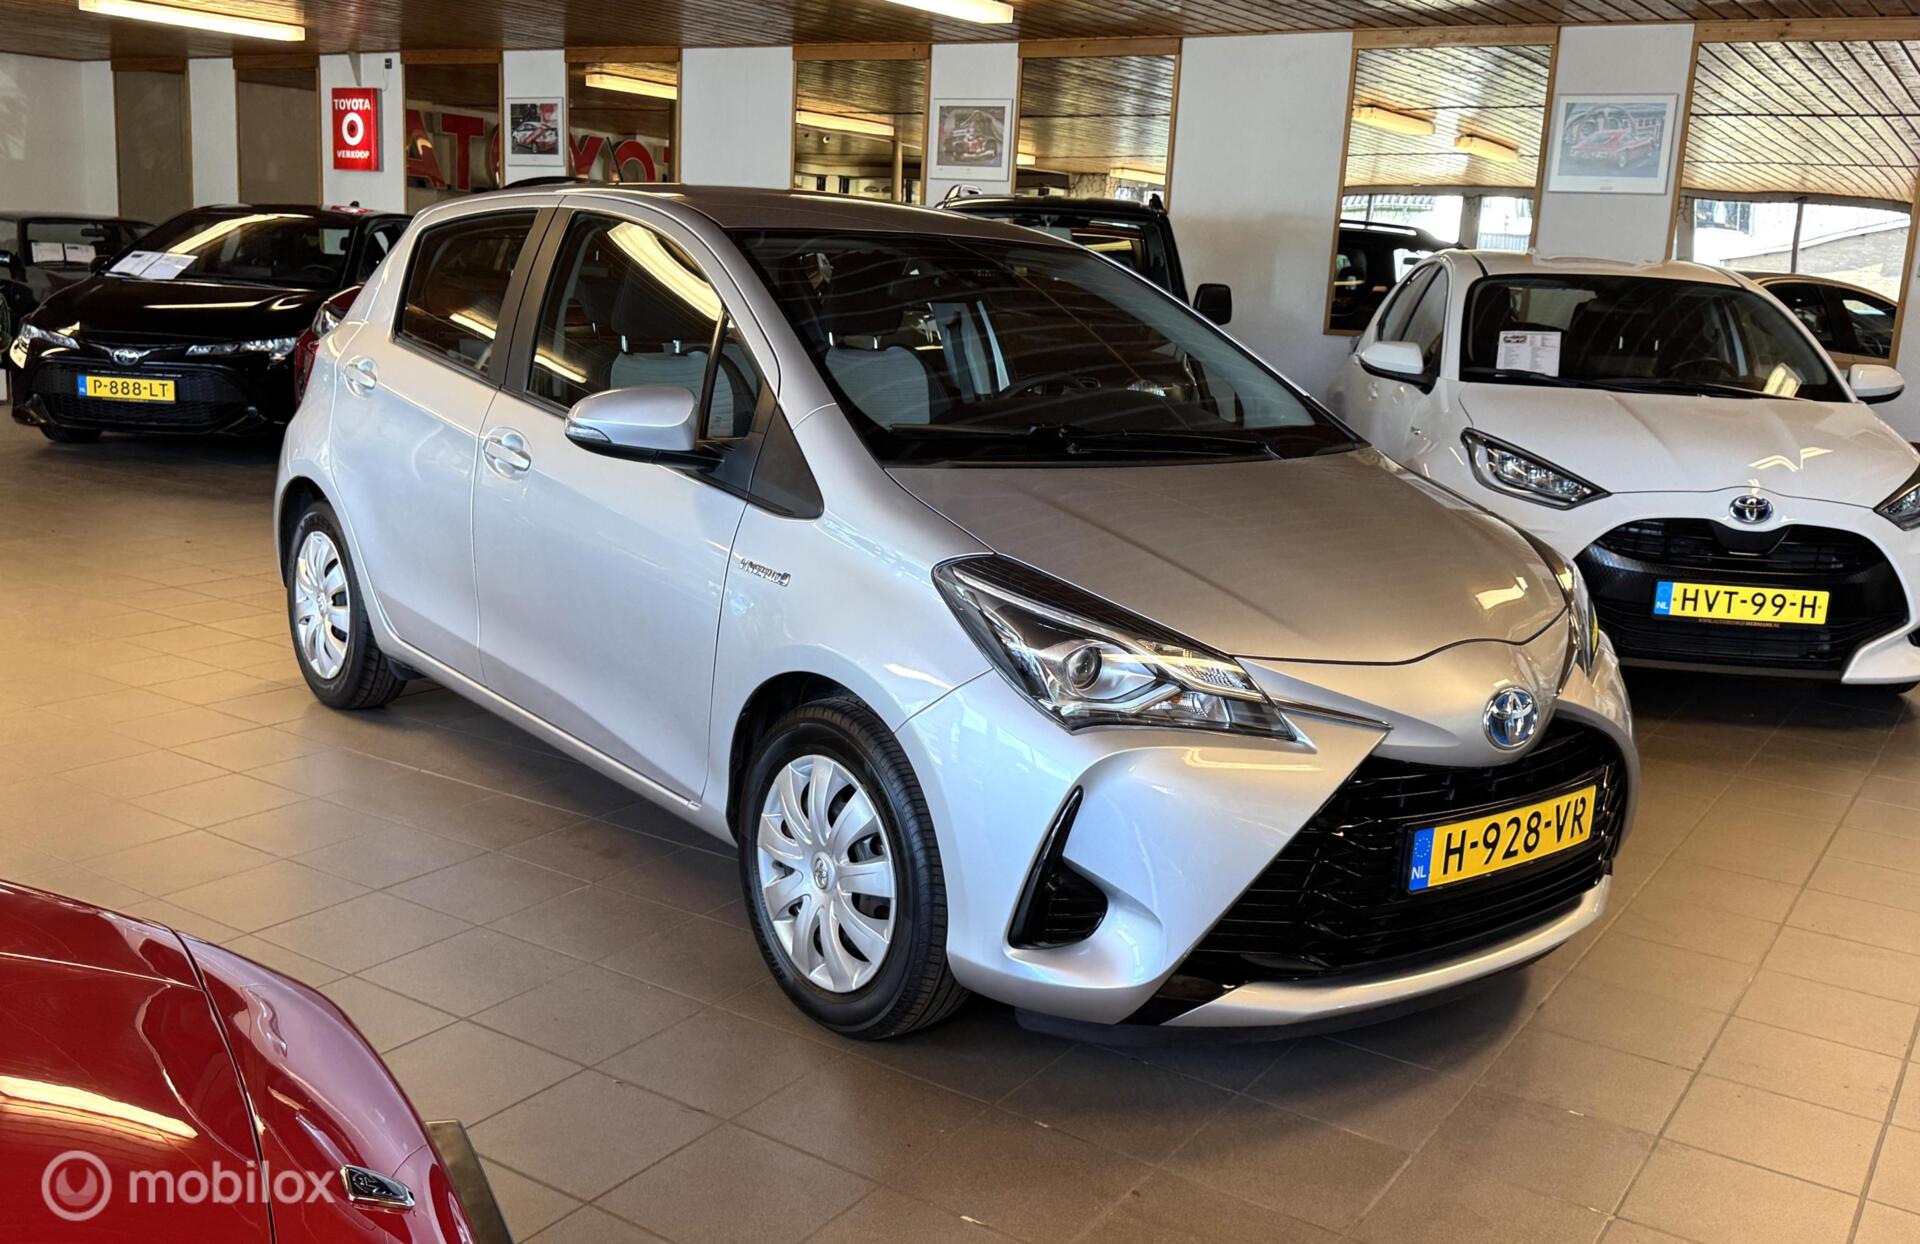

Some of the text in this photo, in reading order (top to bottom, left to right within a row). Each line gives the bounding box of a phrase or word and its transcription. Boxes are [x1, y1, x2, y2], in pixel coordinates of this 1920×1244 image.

[333, 98, 371, 110] TOYOTA
[337, 149, 370, 159] VERKOOP
[93, 379, 168, 397] P-888-LT
[1656, 601, 1668, 610] NL
[1680, 588, 1818, 618] HVT-99-H
[1442, 796, 1587, 875] H-928-VR
[1411, 866, 1427, 880] NL
